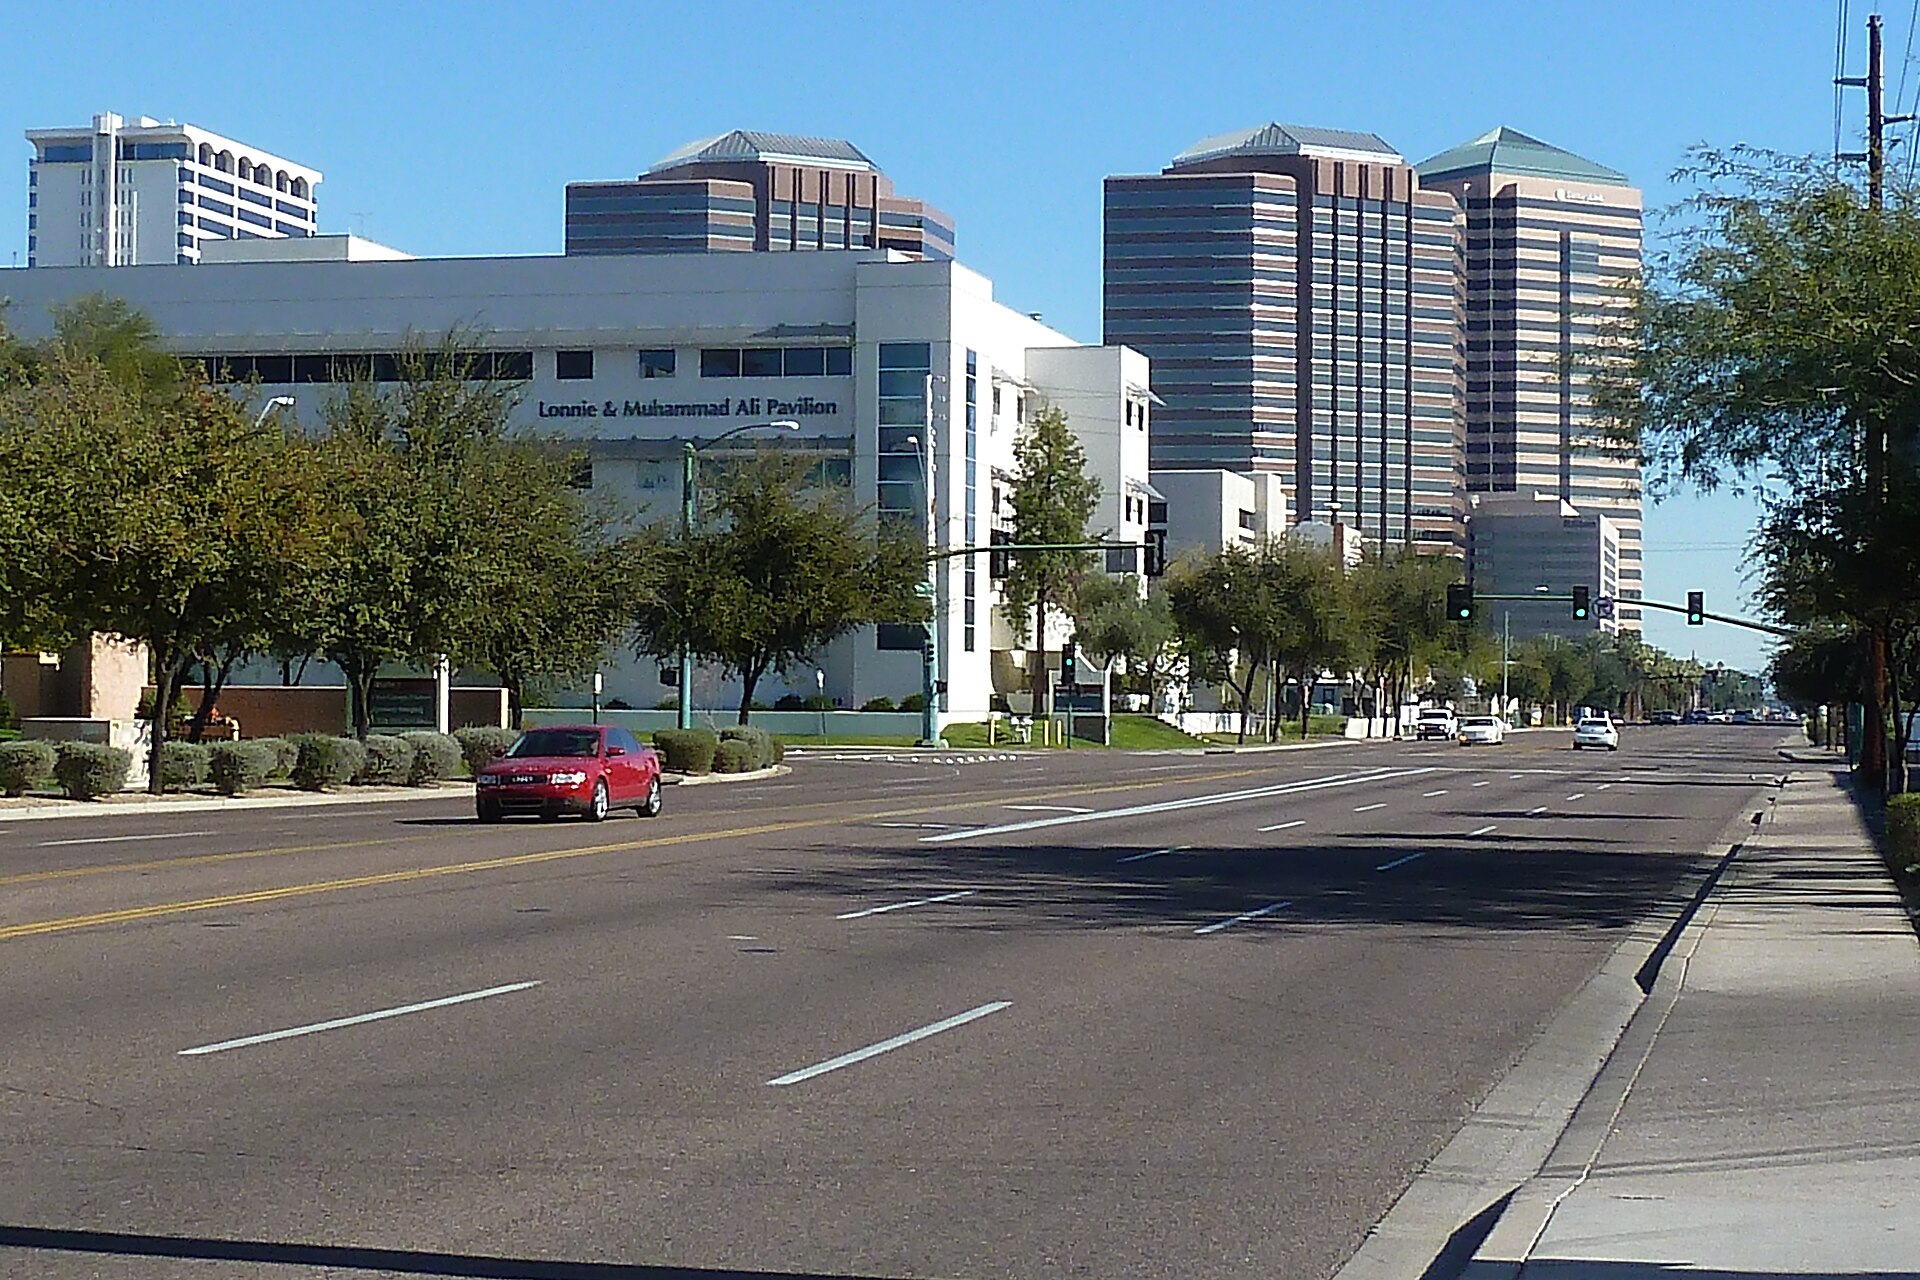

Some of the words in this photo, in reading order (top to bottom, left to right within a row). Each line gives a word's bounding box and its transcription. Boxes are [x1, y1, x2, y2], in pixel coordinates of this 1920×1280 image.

[539, 400, 598, 417] Lonnie
[603, 401, 617, 417] &
[623, 398, 730, 417] Muhammad
[735, 397, 760, 416] Ali
[767, 396, 837, 415] Pavilion
